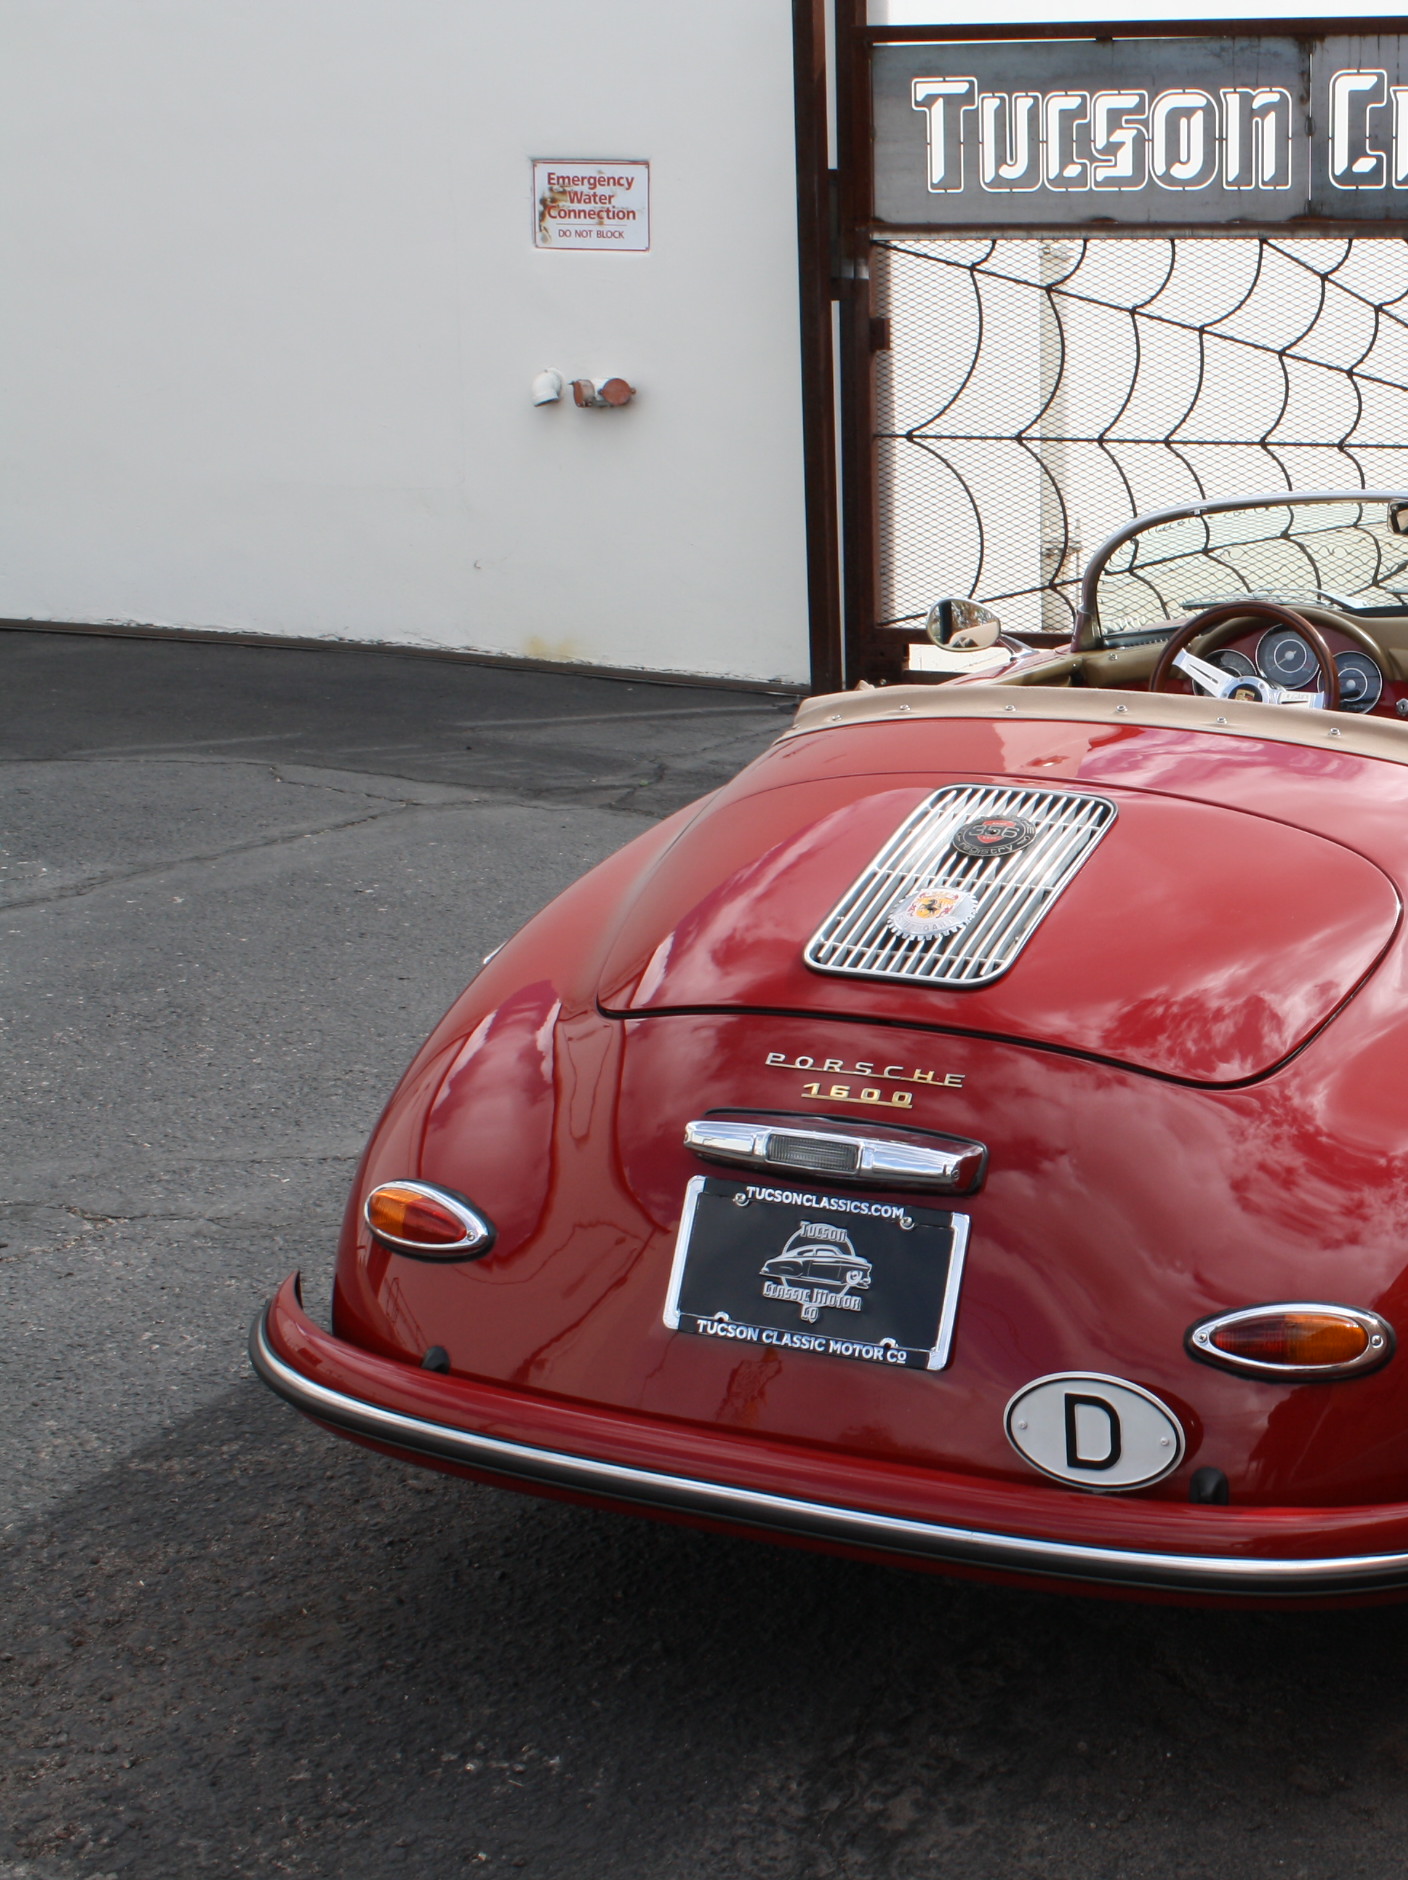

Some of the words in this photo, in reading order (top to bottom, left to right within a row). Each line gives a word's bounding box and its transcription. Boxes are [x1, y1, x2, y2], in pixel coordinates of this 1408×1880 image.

[547, 172, 634, 190] Emergency
[567, 191, 615, 204] Water
[546, 204, 637, 220] Connection
[558, 229, 572, 238] DO
[574, 229, 593, 238] NOT
[596, 230, 624, 239] BLOCK
[968, 824, 1020, 838] 356
[765, 1052, 966, 1088] PORSCHE
[802, 1082, 913, 1106] 1600
[746, 1186, 904, 1219] TUCSONCLASSICS.COM
[763, 1281, 811, 1303] CLASSIC
[697, 1319, 759, 1341] TUCSON
[762, 1329, 826, 1351] CLASSIC
[828, 1340, 884, 1361] MOTOR
[1064, 1392, 1121, 1471] D
